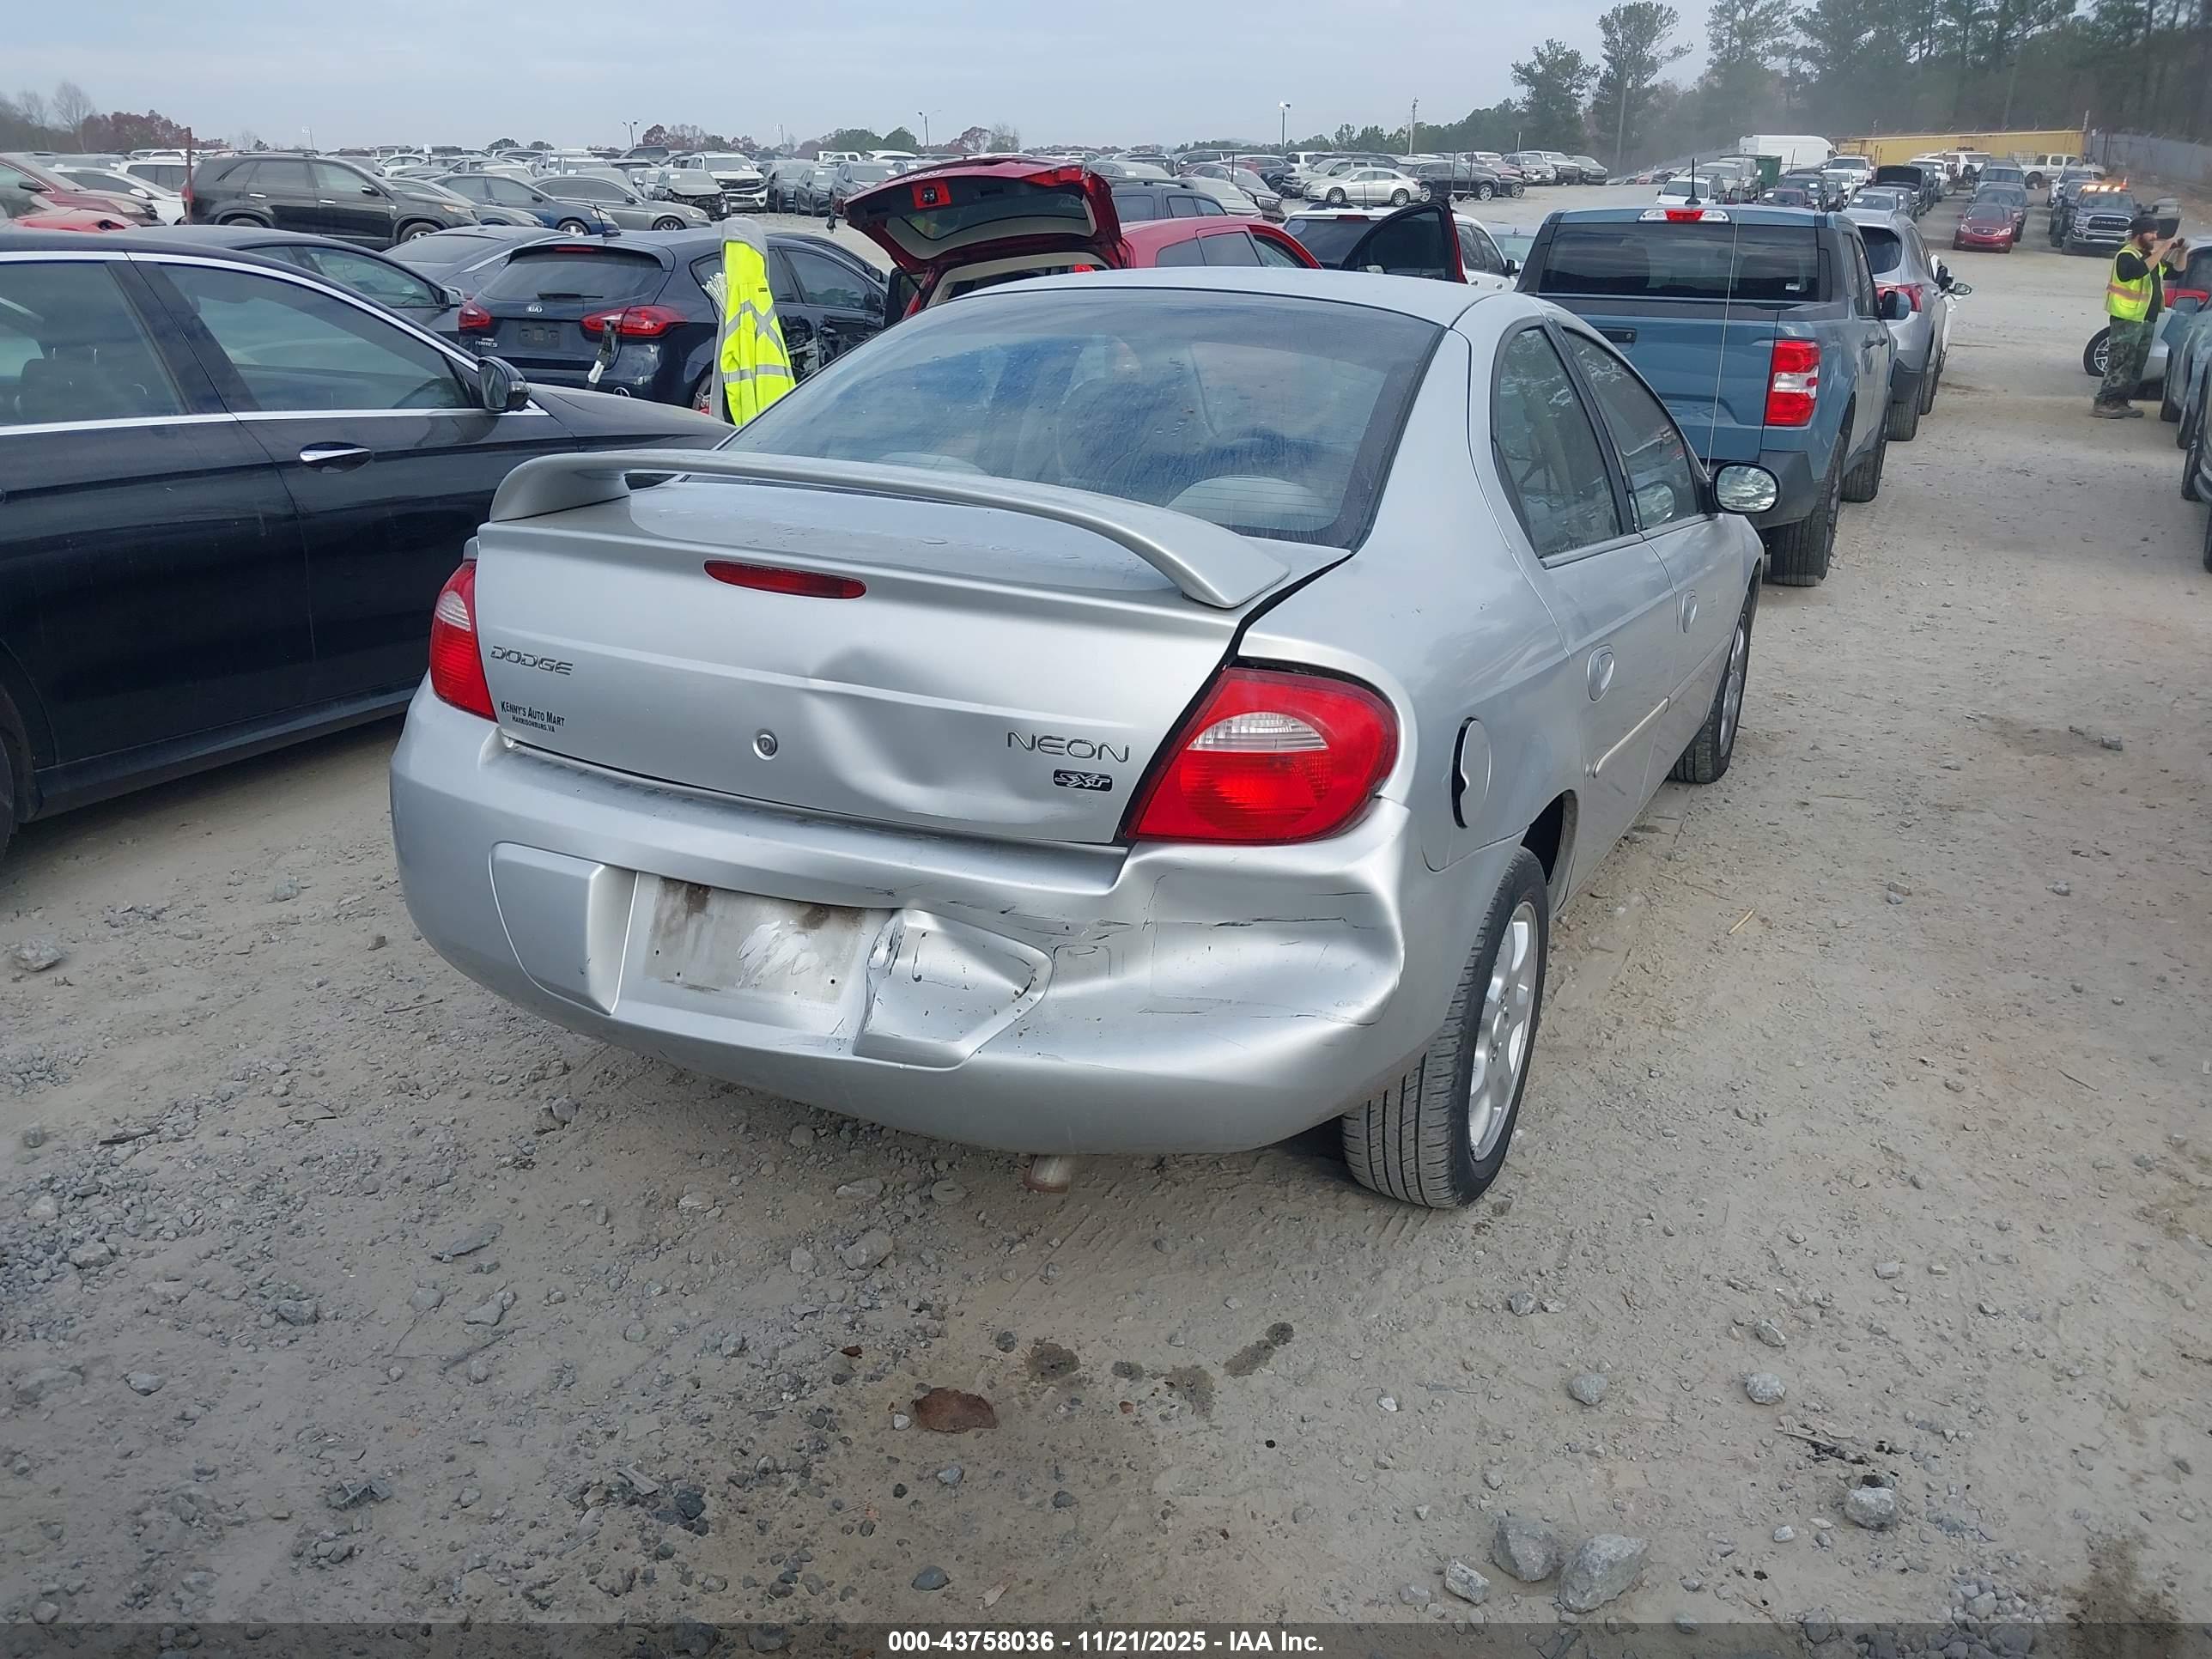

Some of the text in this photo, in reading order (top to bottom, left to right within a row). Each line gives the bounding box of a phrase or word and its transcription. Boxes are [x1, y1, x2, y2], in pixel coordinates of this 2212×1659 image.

[526, 304, 543, 313] KIA
[490, 645, 574, 676] DODGE
[501, 701, 526, 716] KENNY'S
[1007, 731, 1130, 763] NEON
[1054, 772, 1111, 789] SXT
